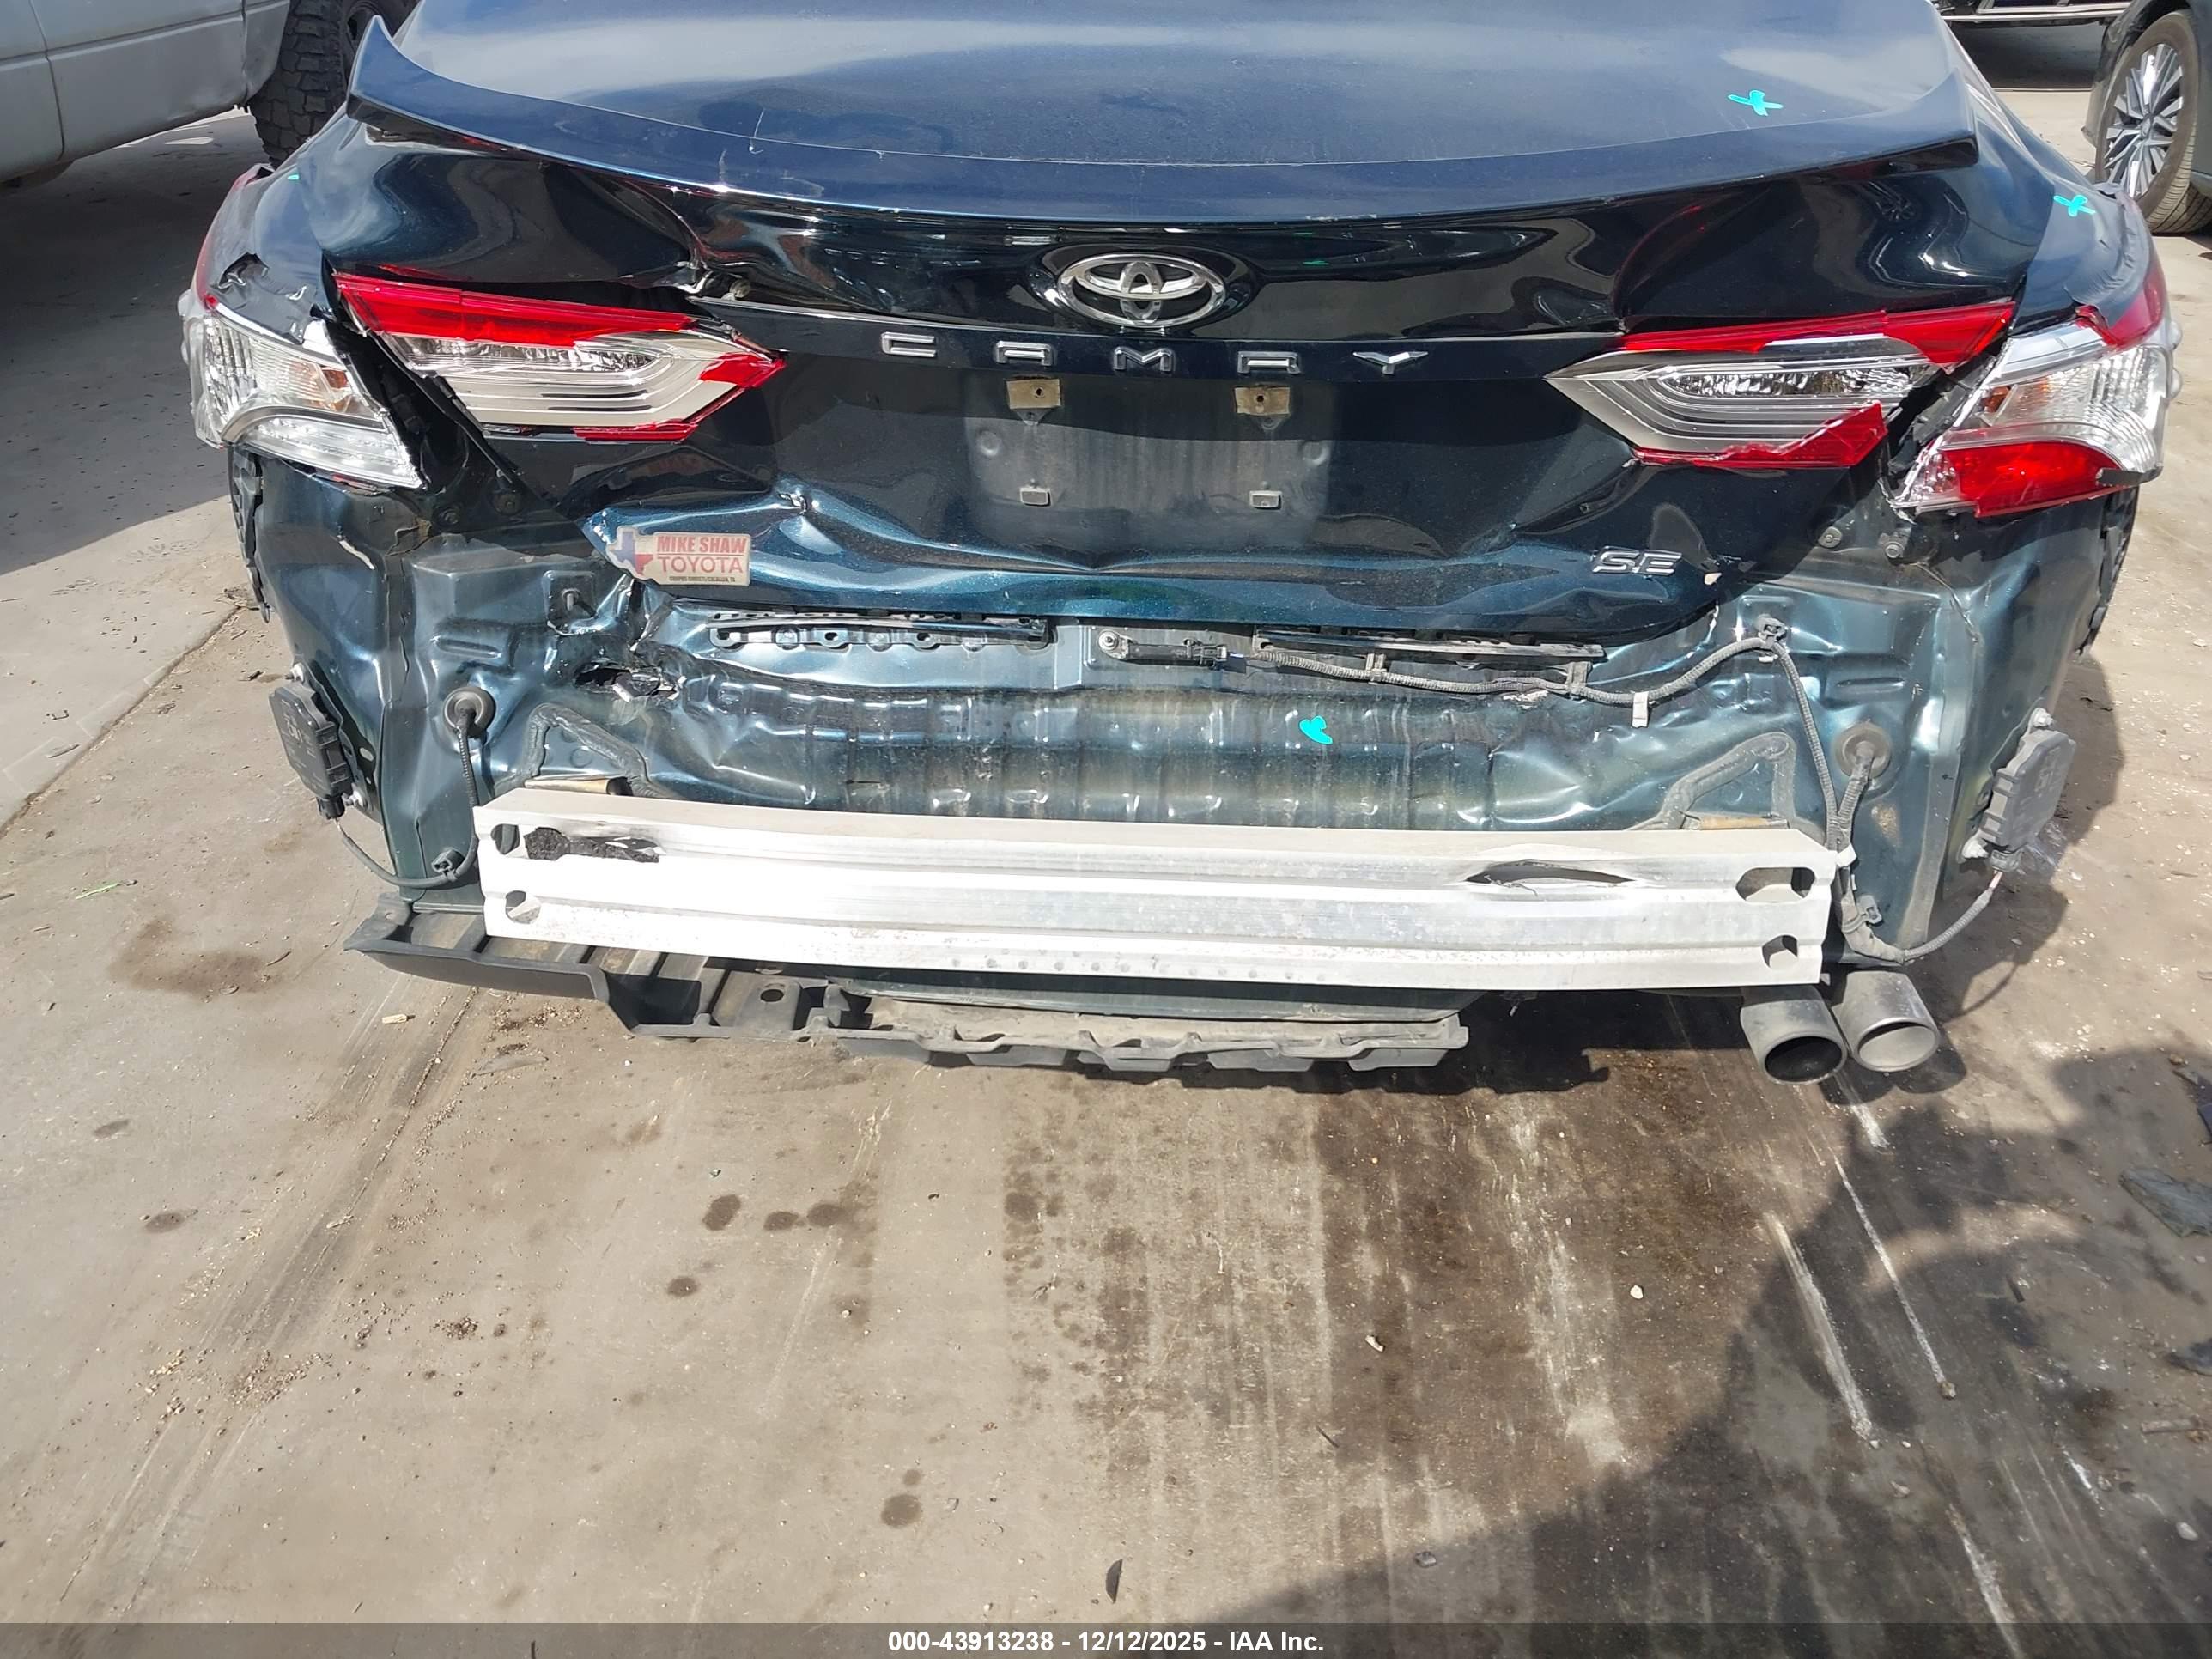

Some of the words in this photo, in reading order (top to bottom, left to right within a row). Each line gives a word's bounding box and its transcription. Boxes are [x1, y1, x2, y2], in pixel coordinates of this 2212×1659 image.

[881, 331, 1429, 374] CAMRY
[657, 536, 696, 552] MIKE
[699, 538, 747, 553] SHAW
[657, 556, 744, 574] TOYOTA
[1592, 545, 1682, 575] SE
